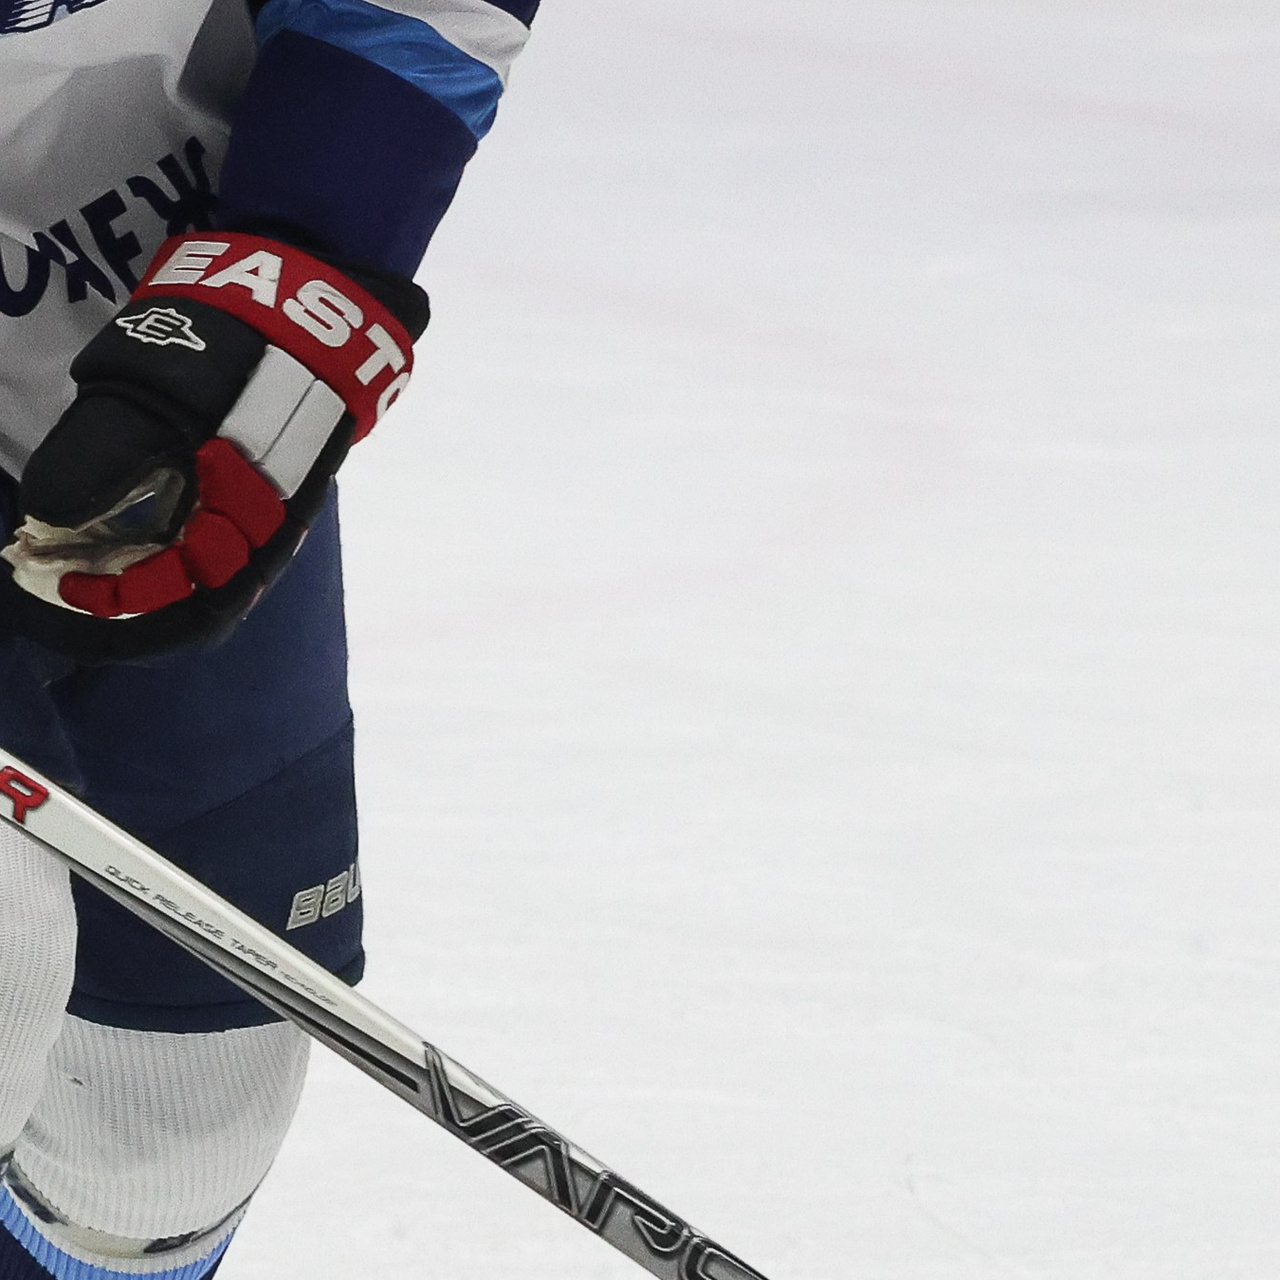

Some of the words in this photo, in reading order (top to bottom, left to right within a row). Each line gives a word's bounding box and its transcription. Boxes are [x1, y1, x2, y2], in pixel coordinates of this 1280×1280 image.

[104, 864, 151, 895] QUICK
[152, 893, 224, 941] RELEASE
[229, 937, 279, 970] TAPER
